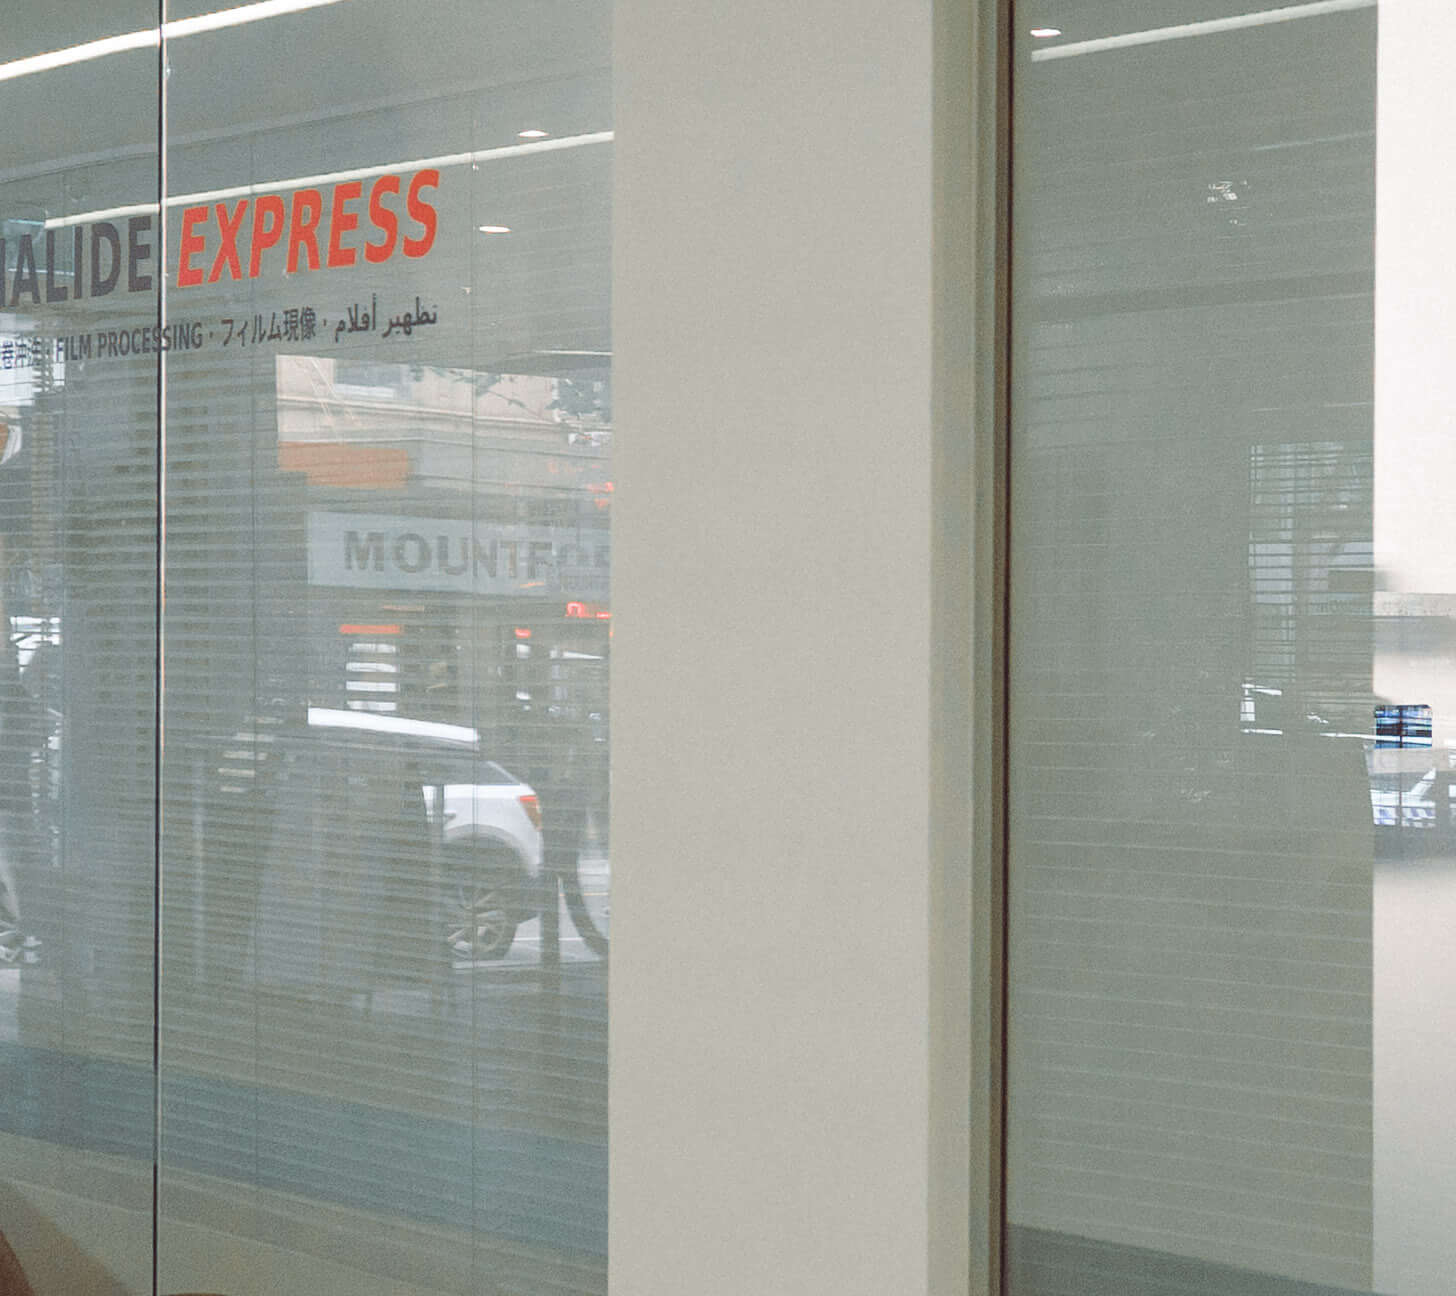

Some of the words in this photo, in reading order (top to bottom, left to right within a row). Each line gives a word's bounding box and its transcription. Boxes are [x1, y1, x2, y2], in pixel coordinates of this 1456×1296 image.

[177, 168, 440, 288] EXPRESS
[57, 334, 92, 363] FILM
[97, 321, 204, 360] PROCESSING
[221, 306, 317, 347] フィルム現像
